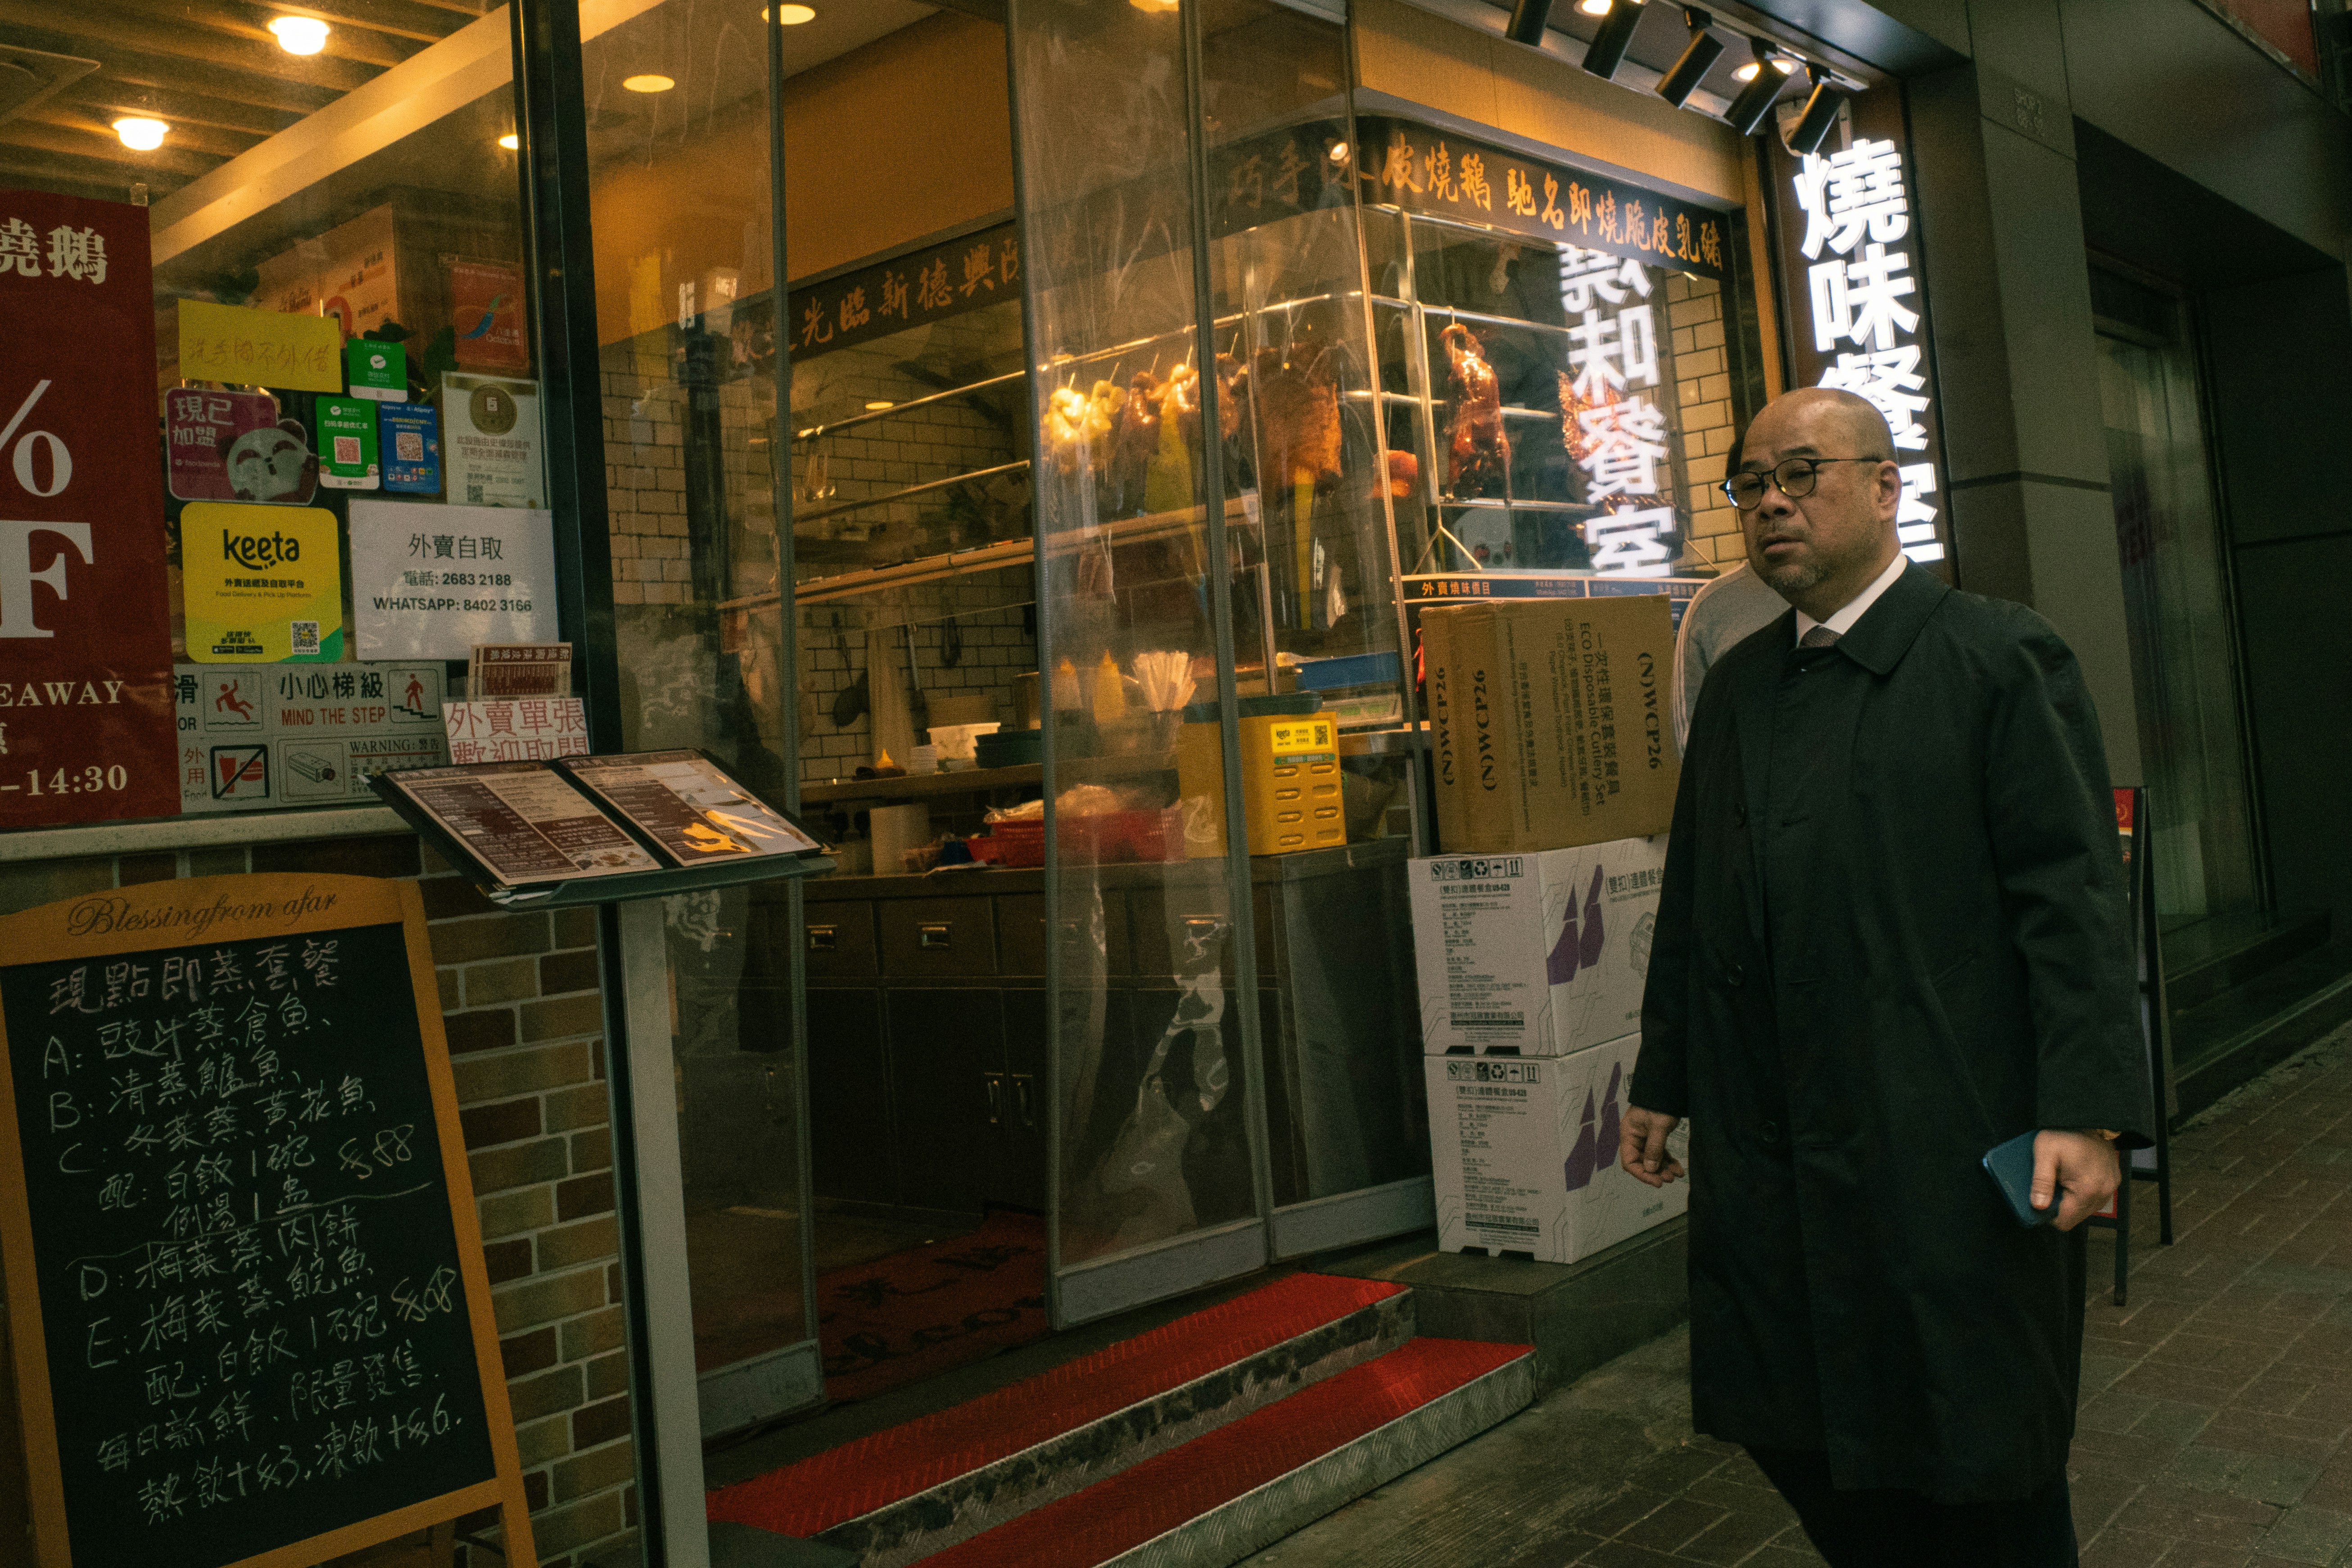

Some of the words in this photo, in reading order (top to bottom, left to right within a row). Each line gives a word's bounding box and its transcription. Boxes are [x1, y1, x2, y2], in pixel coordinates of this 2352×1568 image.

[1507, 168, 1723, 270] 馳名即燒脆皮乳豬
[175, 396, 234, 425] 現已
[173, 425, 217, 447] 加盟
[223, 529, 299, 570] keeta
[408, 533, 504, 560] 外賣自取
[404, 570, 439, 586] 電話:
[442, 573, 475, 586] 2683
[479, 574, 511, 586] 2188
[1421, 581, 1491, 596] 外賣燒味價目
[373, 597, 460, 611] WHATSAPP:
[463, 599, 495, 611] 8402
[500, 599, 532, 612] 3166
[1580, 623, 1593, 649] ECO
[280, 672, 384, 700] 小心梯級
[1581, 654, 1600, 727] Disposable
[281, 709, 314, 726] MIND
[321, 708, 346, 725] THE
[352, 706, 385, 724] STEP
[447, 700, 587, 737] 外賣單張
[1637, 652, 1662, 769] (N)WCP26
[1474, 670, 1498, 791] (N)WCP26
[184, 747, 204, 764] 外
[349, 739, 415, 754] WARNING:
[419, 738, 439, 750] 警告
[1588, 731, 1605, 779] Cutlery
[187, 768, 205, 785] 用
[1595, 784, 1607, 805] Set
[50, 939, 339, 1014] 現點即蒸套餐
[44, 1035, 83, 1078] A:
[50, 1093, 94, 1133] B:
[81, 1265, 122, 1301] D:
[88, 1317, 130, 1368] E:
